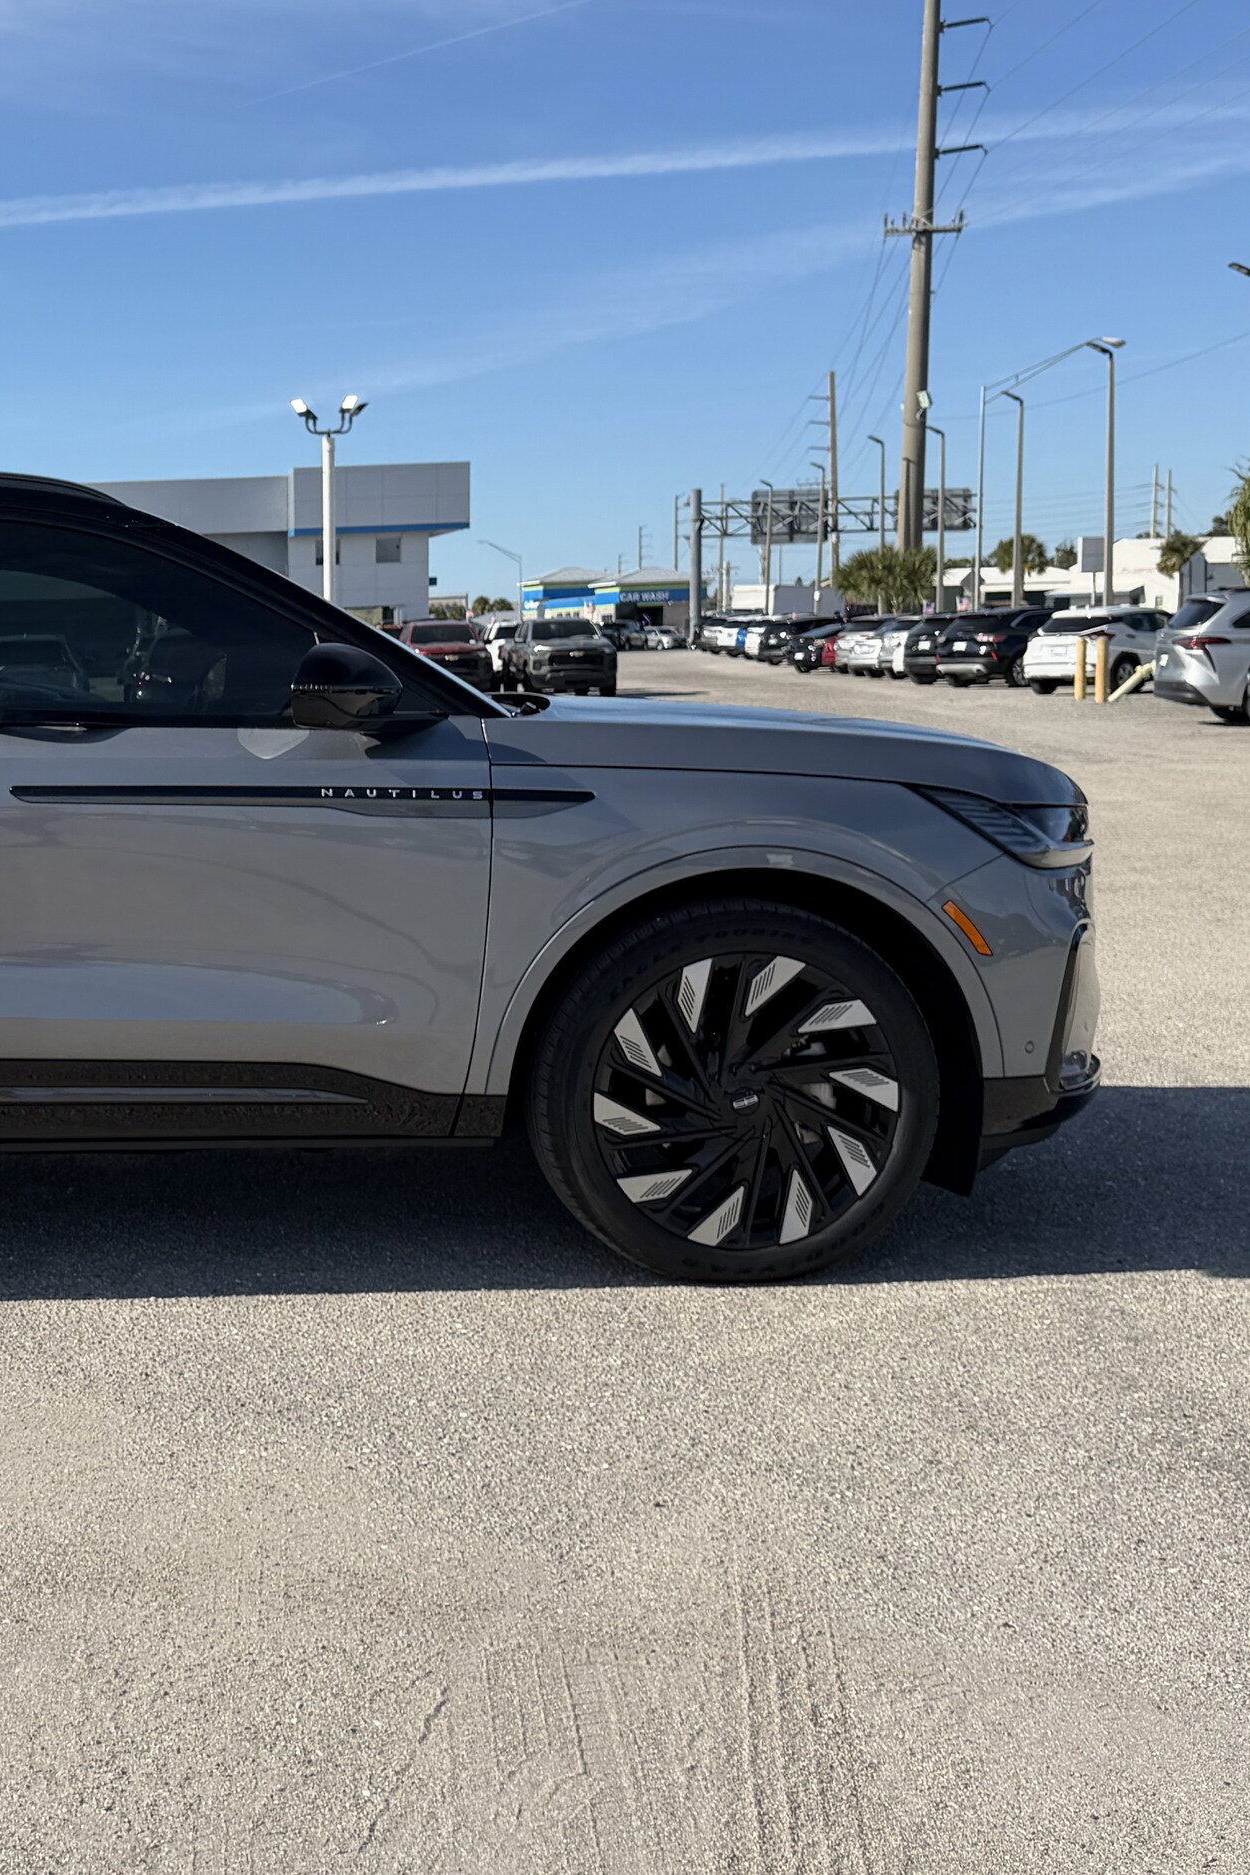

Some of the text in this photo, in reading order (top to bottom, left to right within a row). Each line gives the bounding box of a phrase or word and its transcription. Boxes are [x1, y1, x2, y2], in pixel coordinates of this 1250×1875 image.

[620, 591, 669, 602] CAR WASH
[321, 788, 483, 799] NAUTILUS
